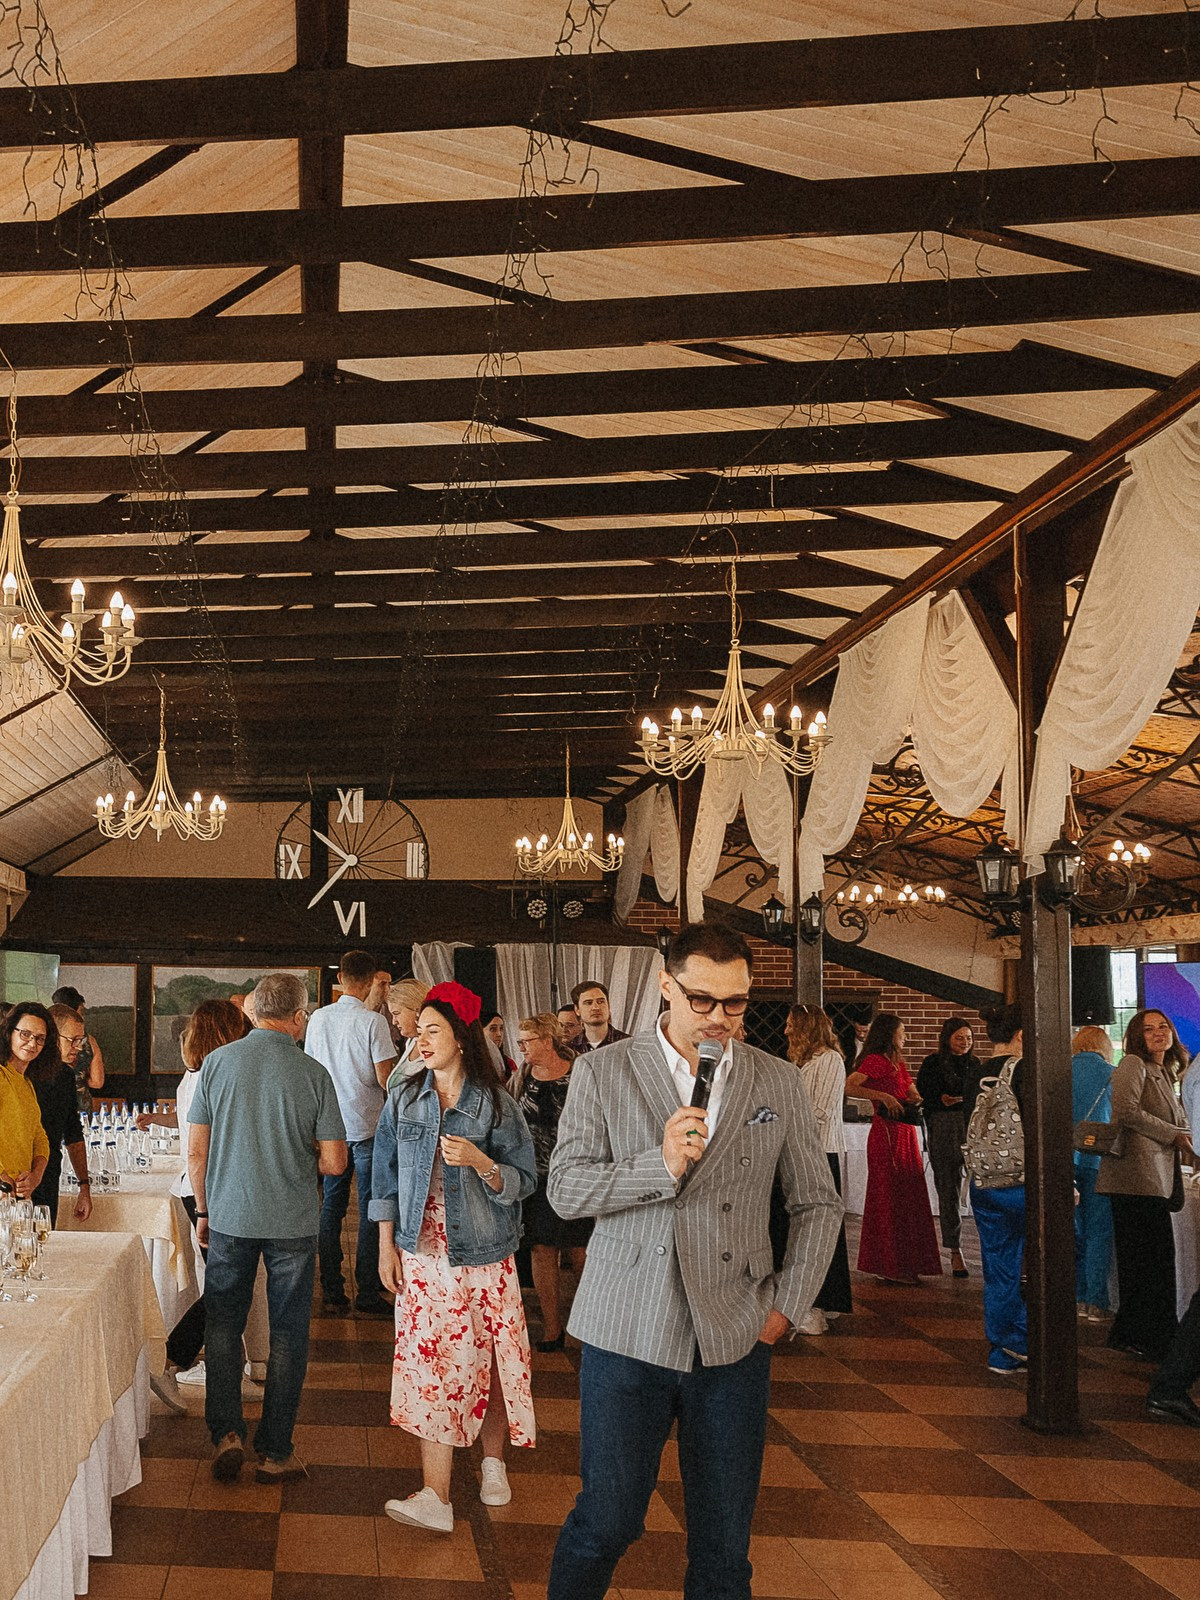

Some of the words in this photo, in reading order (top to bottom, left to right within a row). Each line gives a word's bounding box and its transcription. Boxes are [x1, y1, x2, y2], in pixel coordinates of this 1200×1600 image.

[337, 788, 364, 823] XII
[279, 844, 303, 879] IX
[406, 842, 424, 878] III
[333, 900, 366, 937] VI
